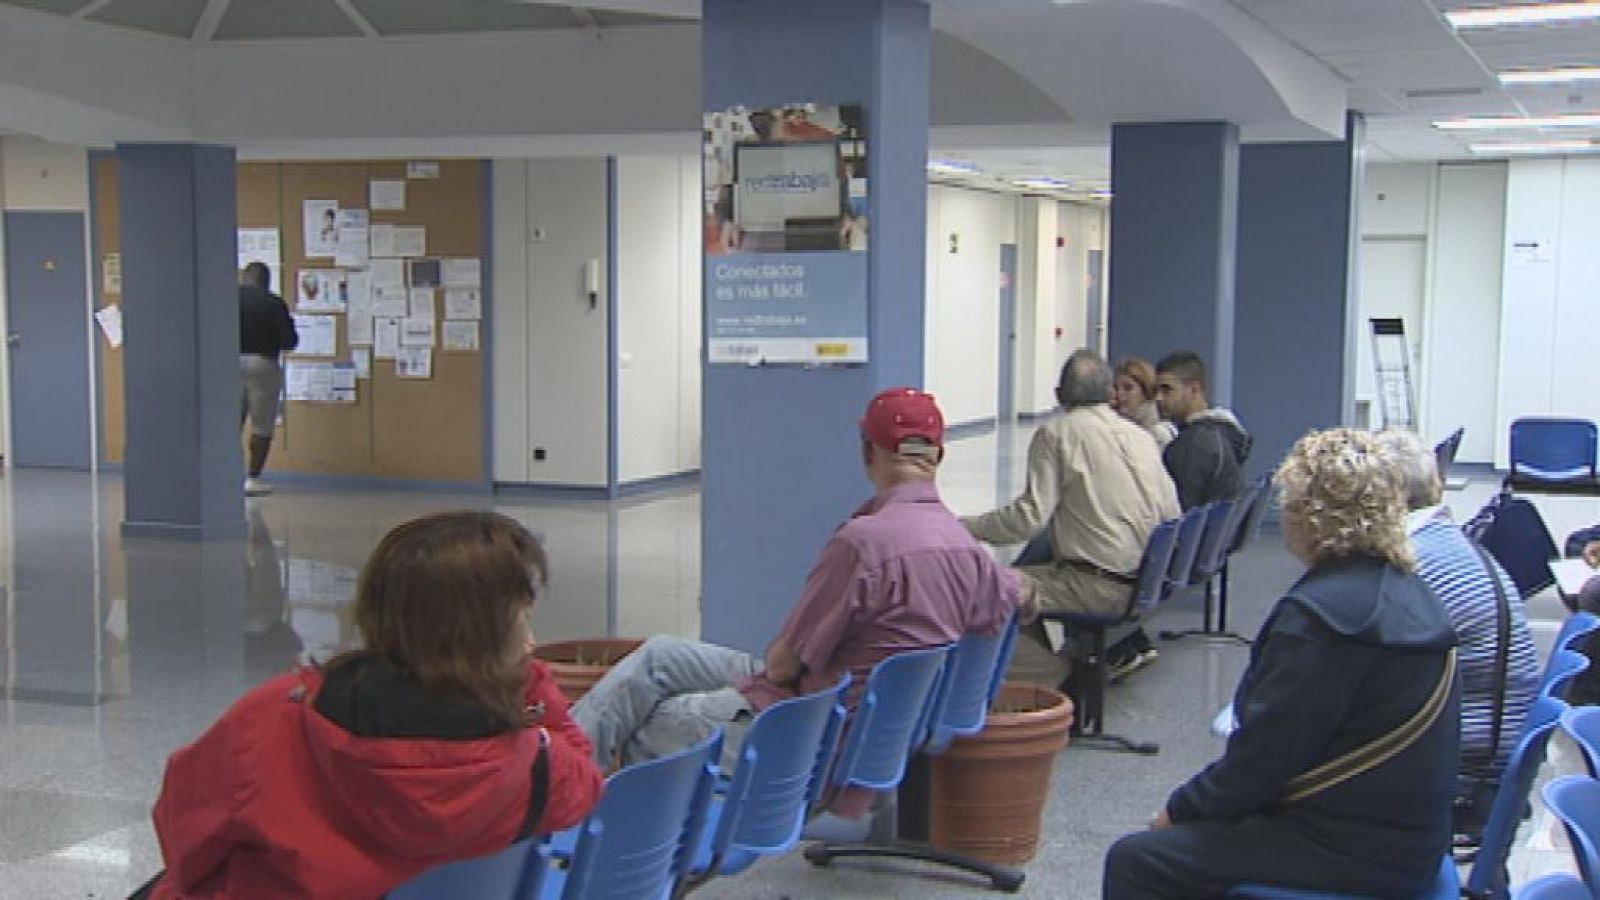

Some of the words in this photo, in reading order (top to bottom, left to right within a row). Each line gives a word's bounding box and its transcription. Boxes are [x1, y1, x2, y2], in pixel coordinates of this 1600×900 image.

[715, 263, 804, 279] Conectados
[715, 285, 734, 300] es
[737, 282, 769, 299] más
